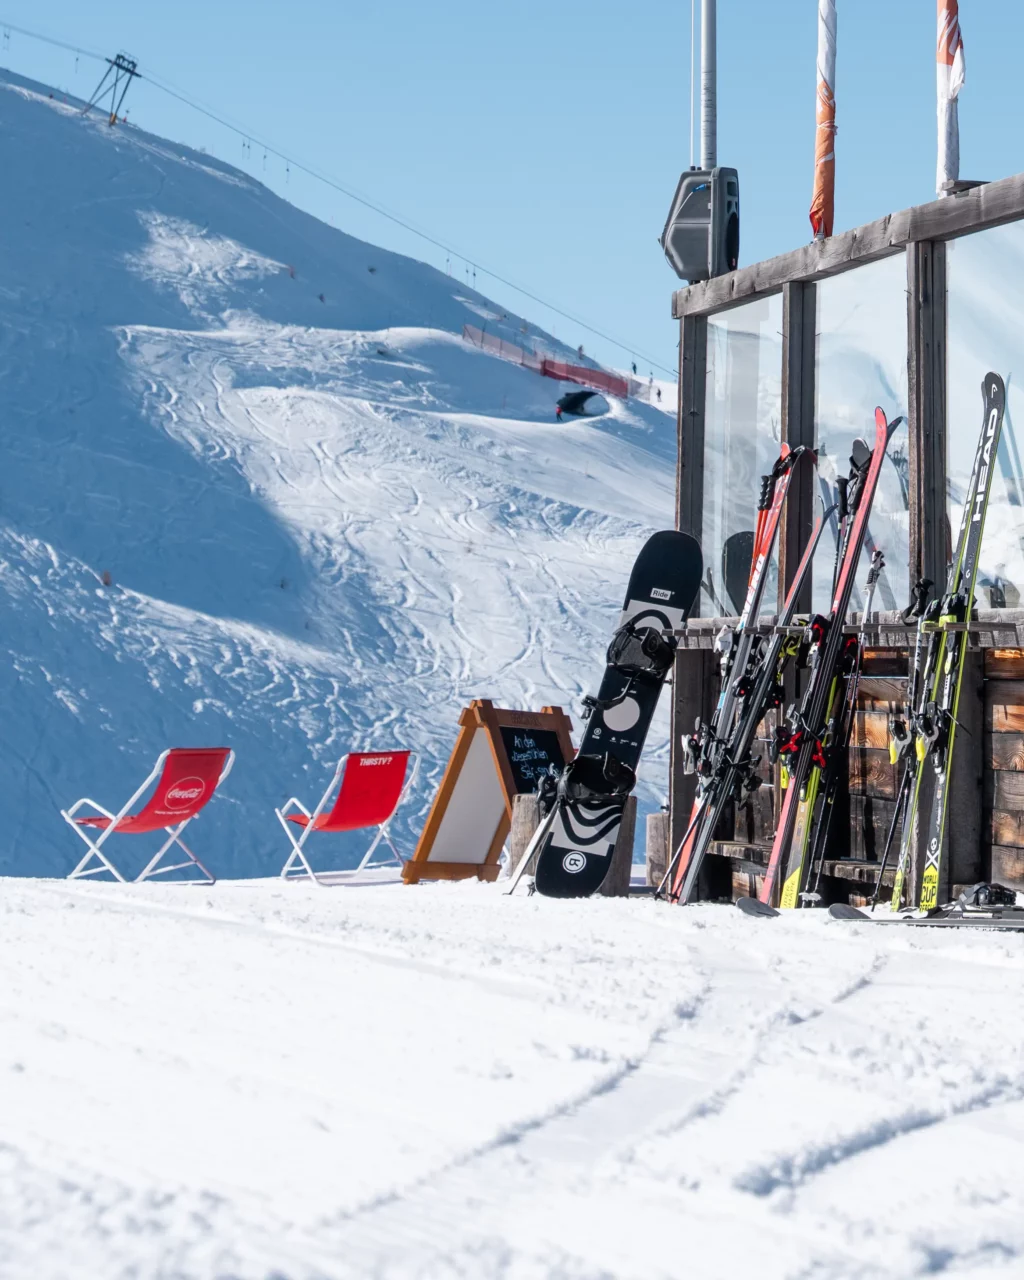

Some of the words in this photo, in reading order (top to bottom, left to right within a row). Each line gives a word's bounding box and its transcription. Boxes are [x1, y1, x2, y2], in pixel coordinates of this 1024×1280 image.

[972, 408, 998, 522] HEAD
[653, 589, 669, 599] Ride
[920, 885, 937, 904] CUP
